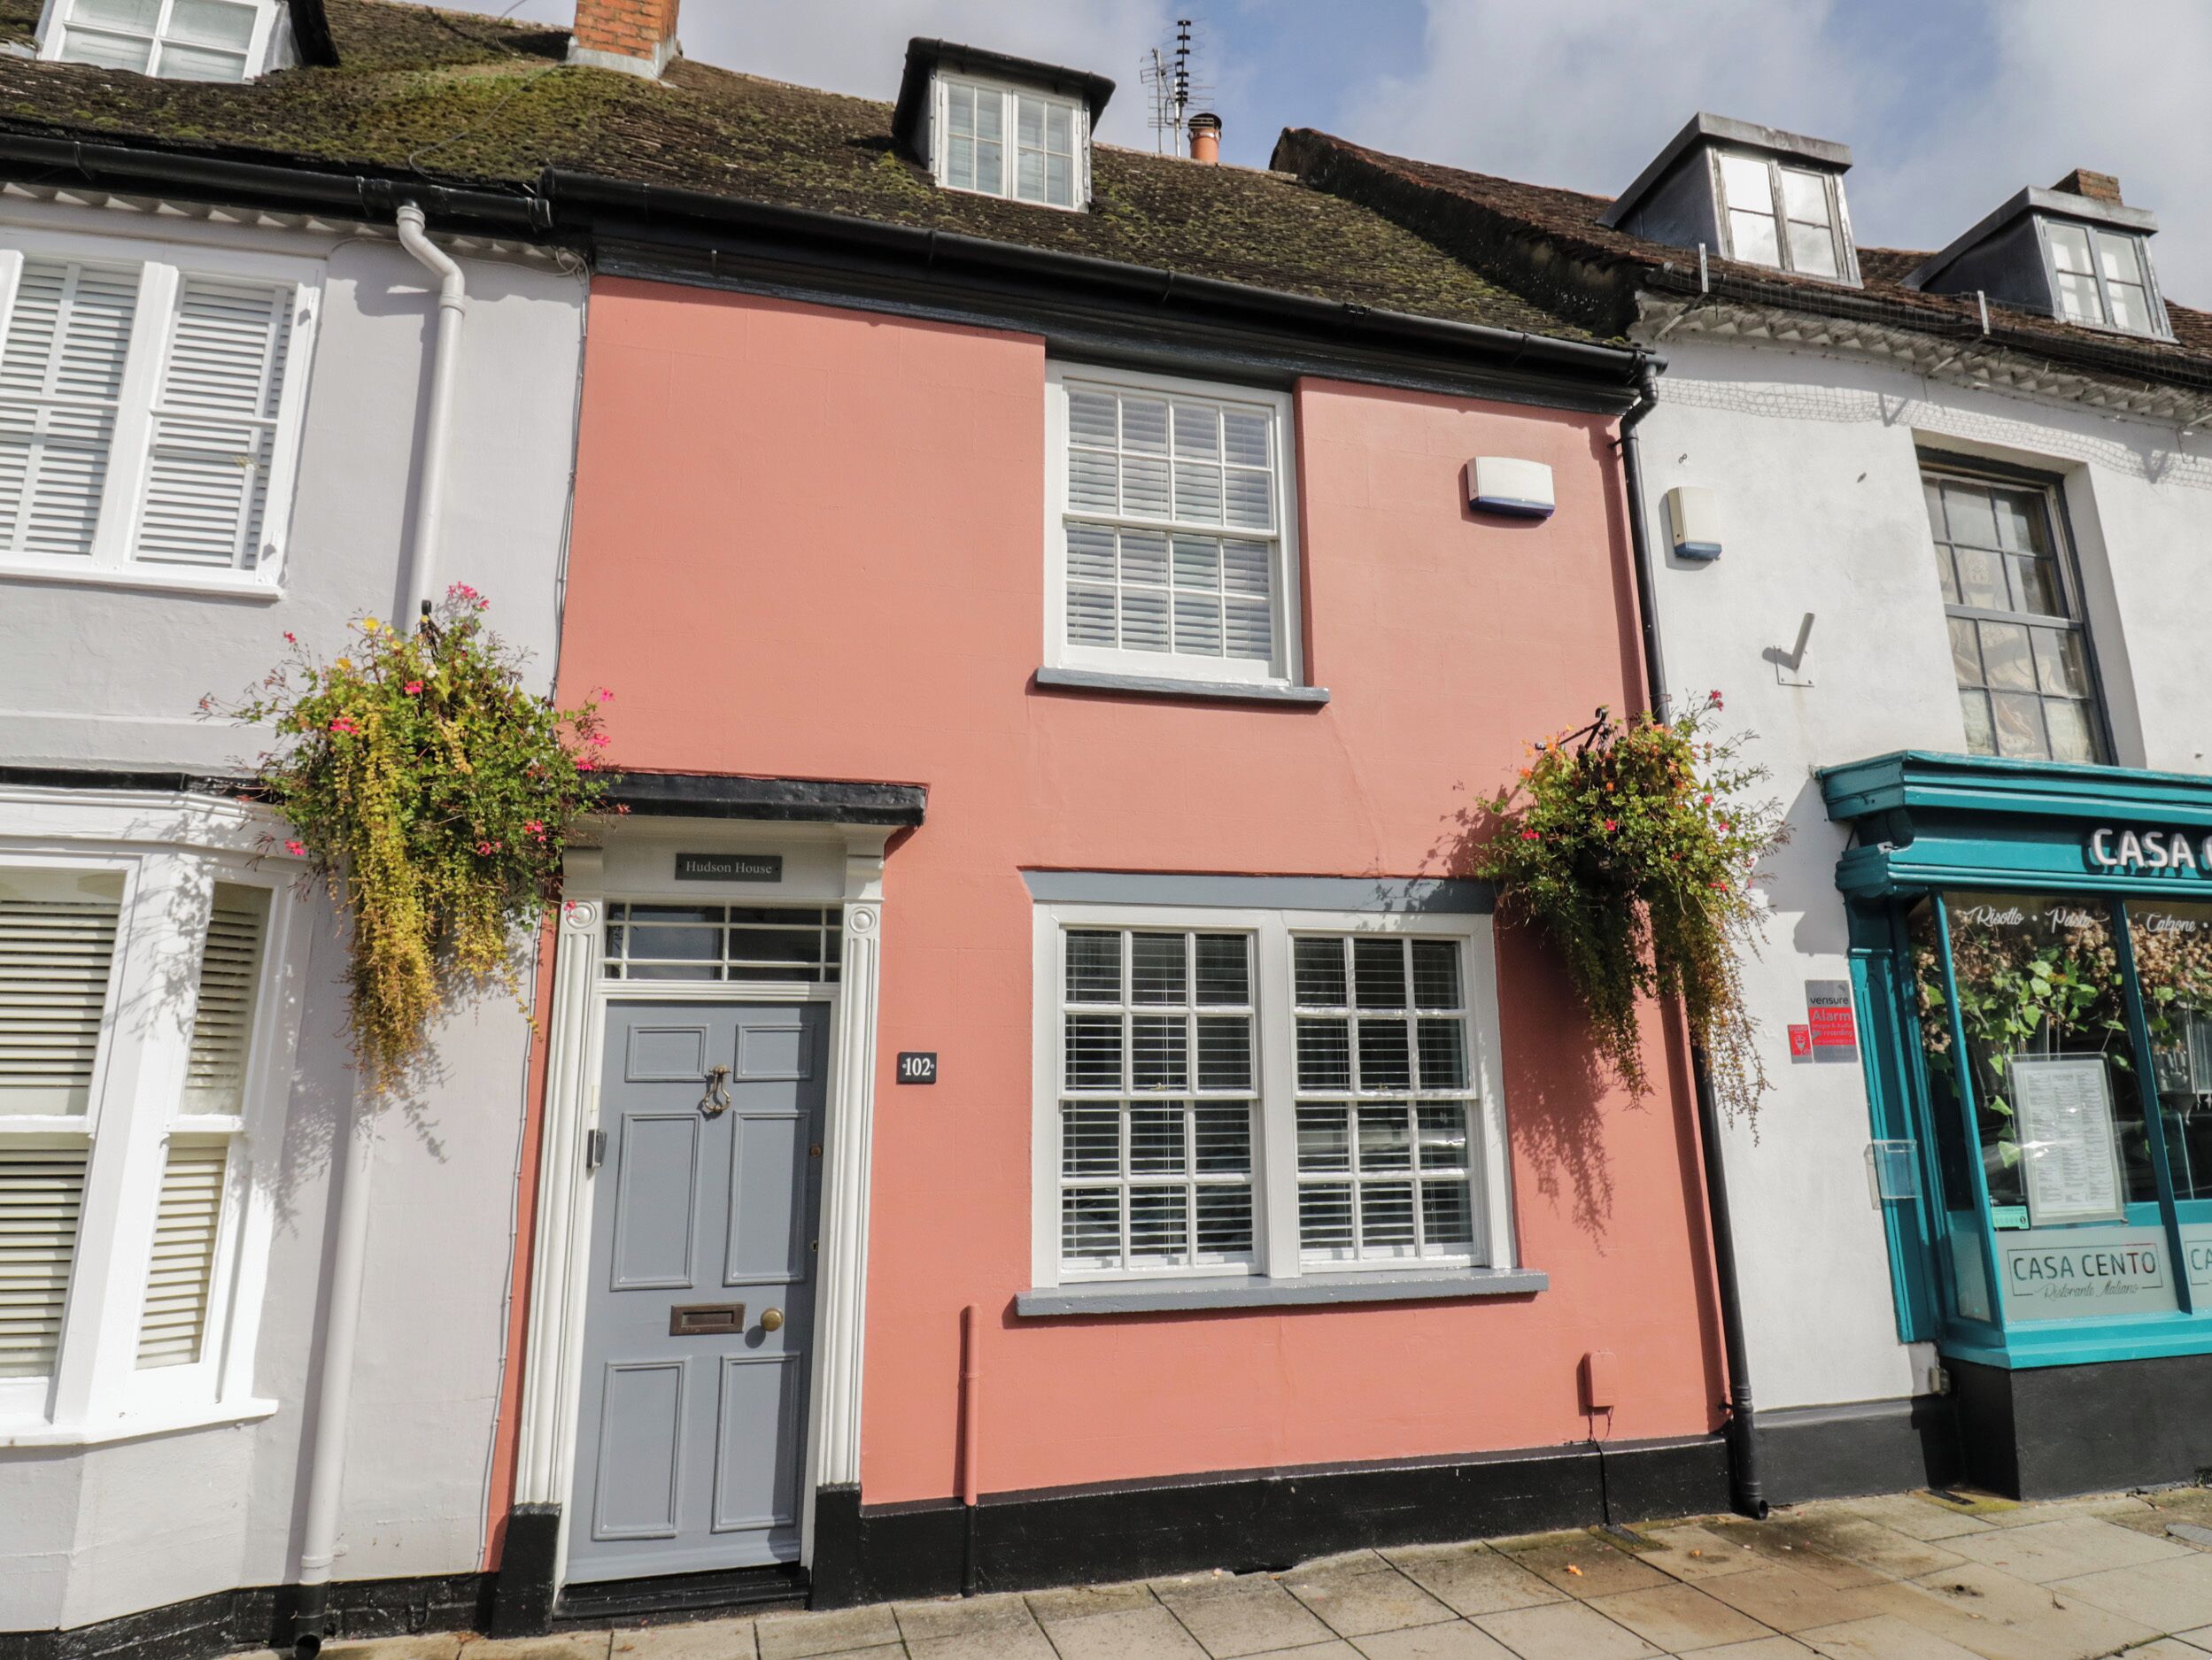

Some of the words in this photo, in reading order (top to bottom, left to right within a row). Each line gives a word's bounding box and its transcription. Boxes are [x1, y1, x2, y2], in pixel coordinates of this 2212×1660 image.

[2090, 828, 2196, 869] CASA
[685, 861, 731, 873] Hudson
[735, 862, 773, 874] House
[1964, 905, 2024, 927] Risotto
[2045, 905, 2110, 934] Pasta
[1813, 1009, 1852, 1022] Alarm
[905, 1057, 932, 1077] 102
[2013, 1255, 2075, 1281] CASA
[2081, 1251, 2156, 1278] CENTO
